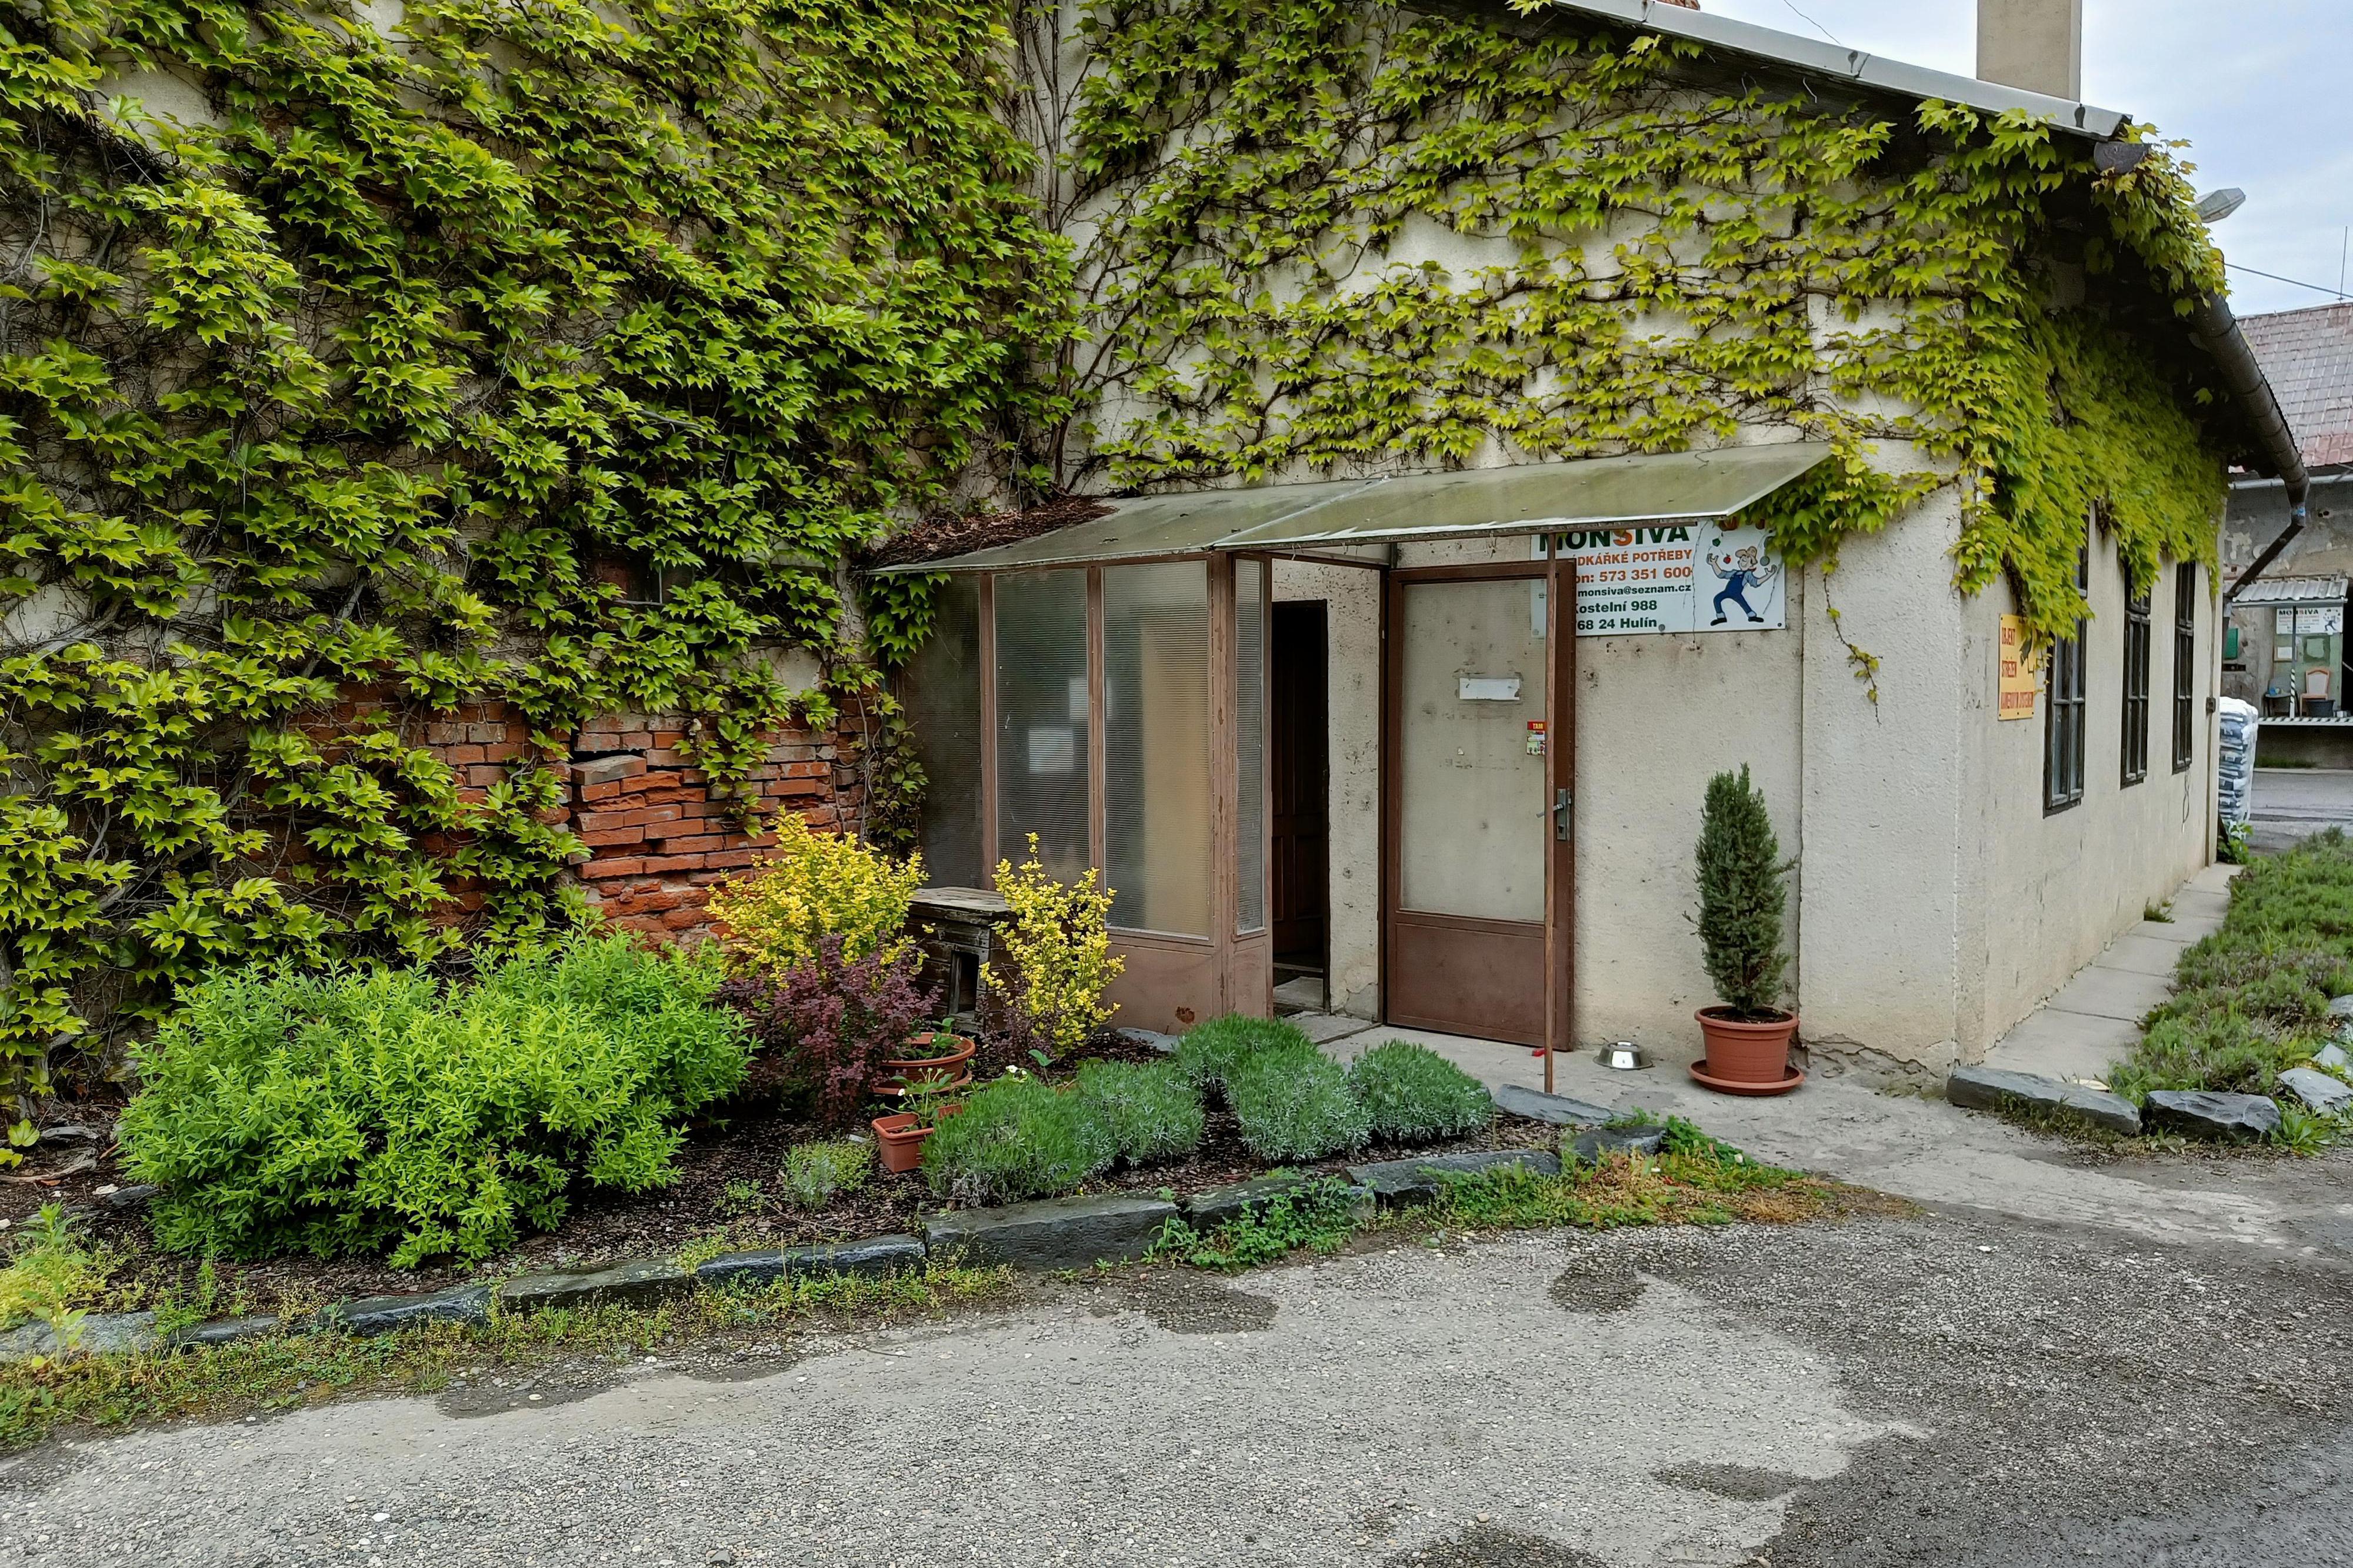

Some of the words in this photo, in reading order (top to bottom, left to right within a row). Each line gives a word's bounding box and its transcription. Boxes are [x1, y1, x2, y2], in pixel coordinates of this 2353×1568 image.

[1573, 551, 1629, 566] DKÁŘKÉ
[1632, 548, 1692, 562] POTŘEBY
[1576, 575, 1594, 583] on:
[1599, 571, 1627, 582] 573
[1631, 568, 1657, 581] 351
[1663, 566, 1691, 579] 600
[1578, 585, 1692, 597] monsiva@seznam.cz
[1631, 600, 1658, 611] 988
[1577, 619, 1594, 630] 68
[1598, 619, 1615, 630] 24
[1619, 617, 1658, 629] Hulín
